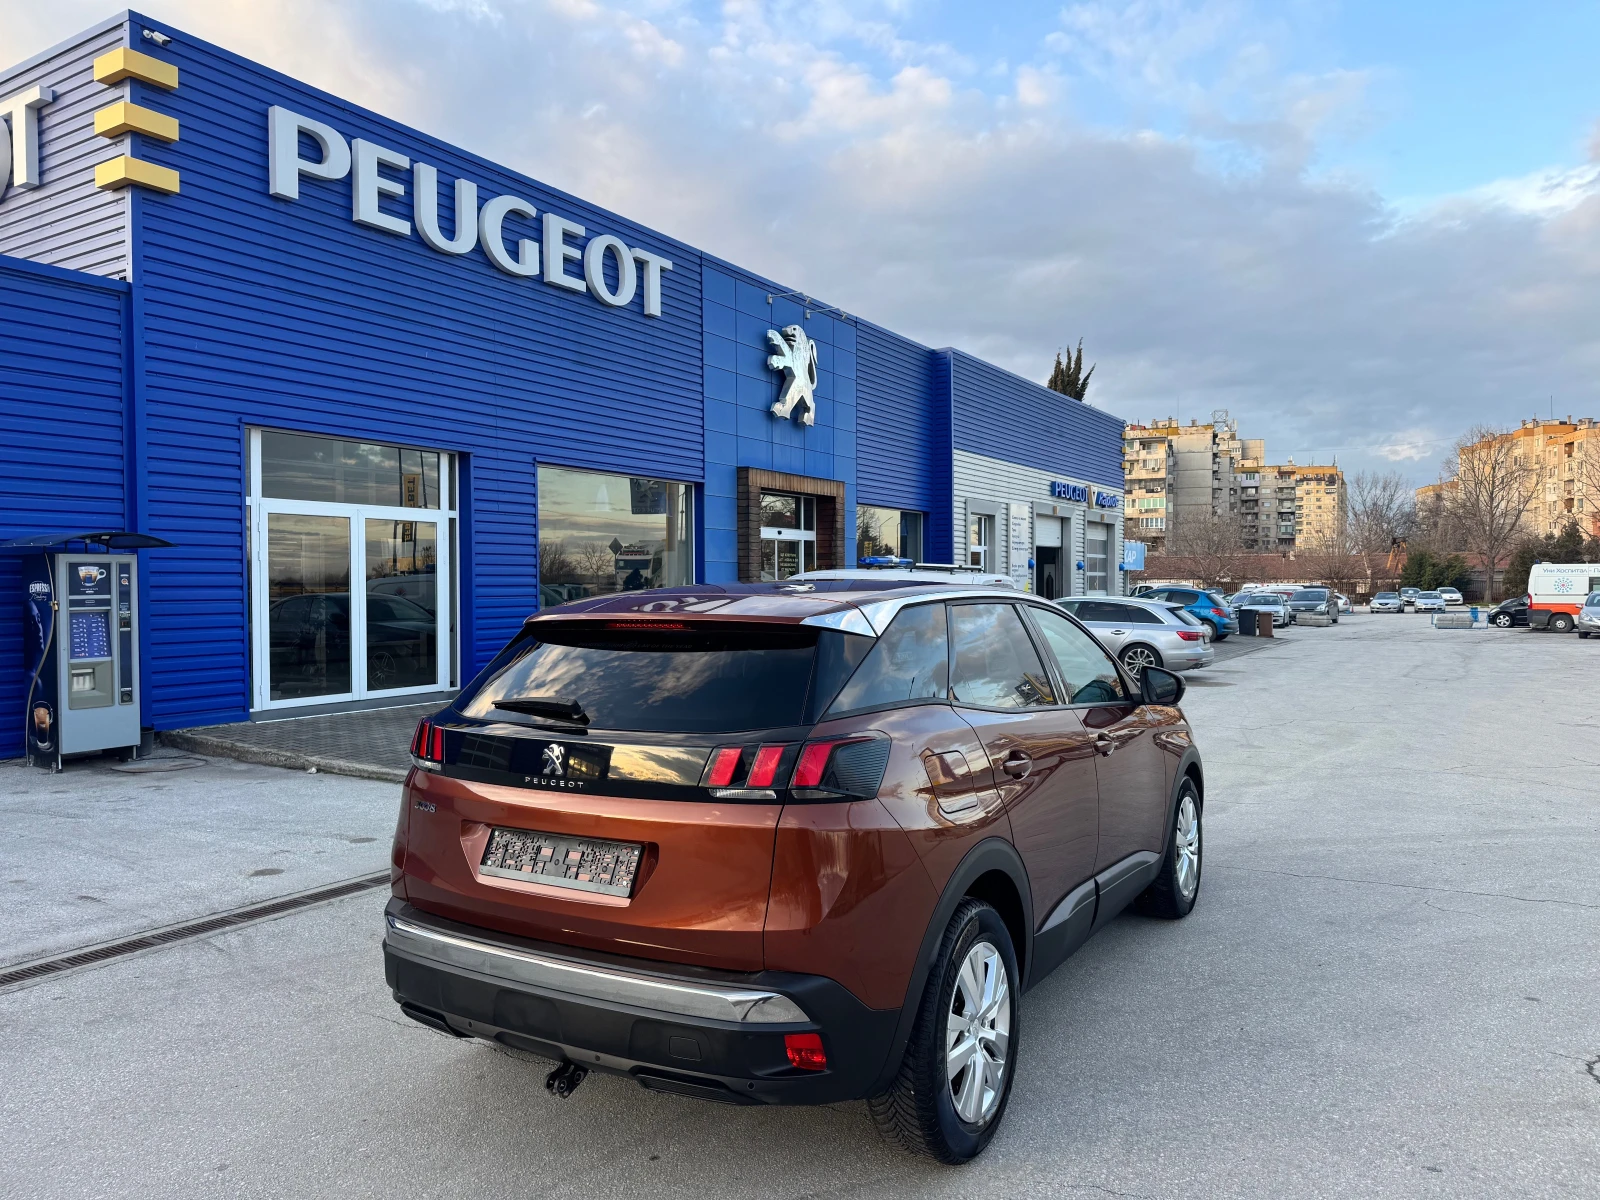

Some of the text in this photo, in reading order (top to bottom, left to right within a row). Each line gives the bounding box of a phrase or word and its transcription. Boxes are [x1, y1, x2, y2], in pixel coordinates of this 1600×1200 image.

[267, 105, 673, 316] PEUGEOT
[1055, 481, 1088, 503] PEUGEOT
[524, 776, 584, 789] PEUGEOT
